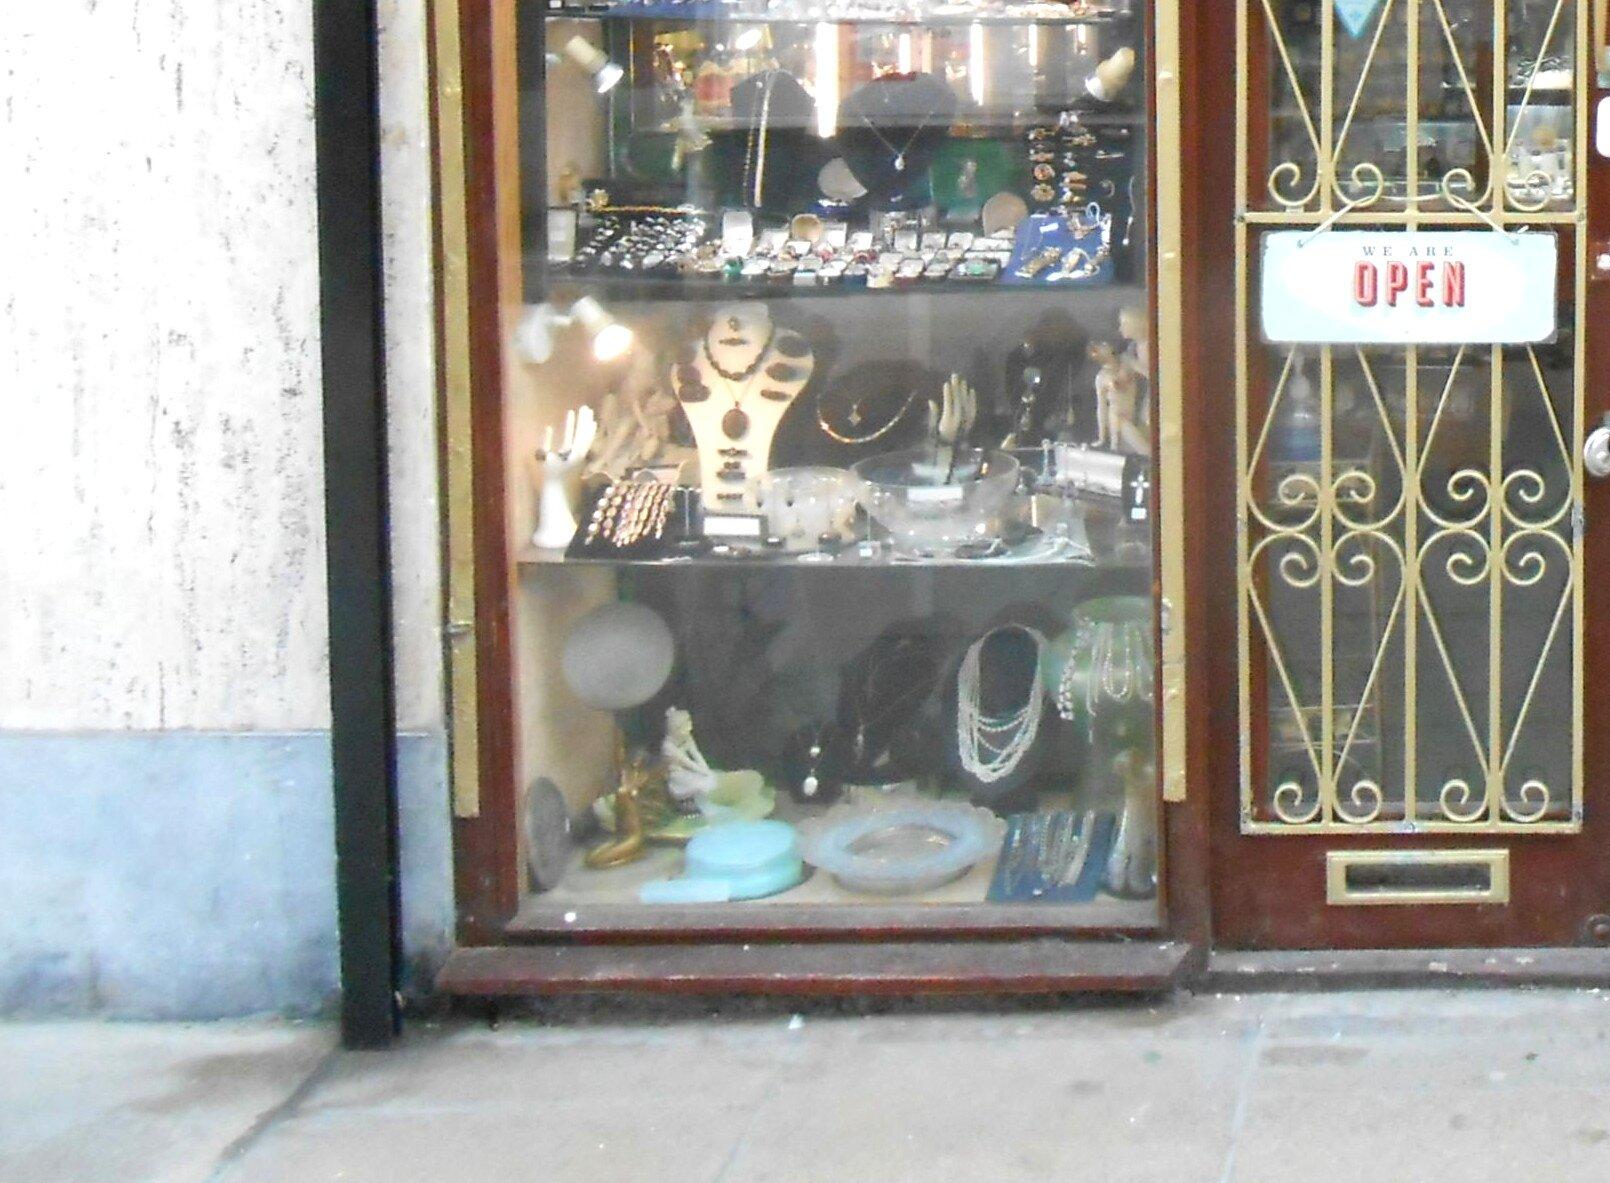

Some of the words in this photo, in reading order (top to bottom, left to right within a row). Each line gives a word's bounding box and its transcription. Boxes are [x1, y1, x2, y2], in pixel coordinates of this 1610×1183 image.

[1362, 245, 1393, 258] WE
[1409, 245, 1455, 258] ARE
[1353, 260, 1466, 308] OPEN
